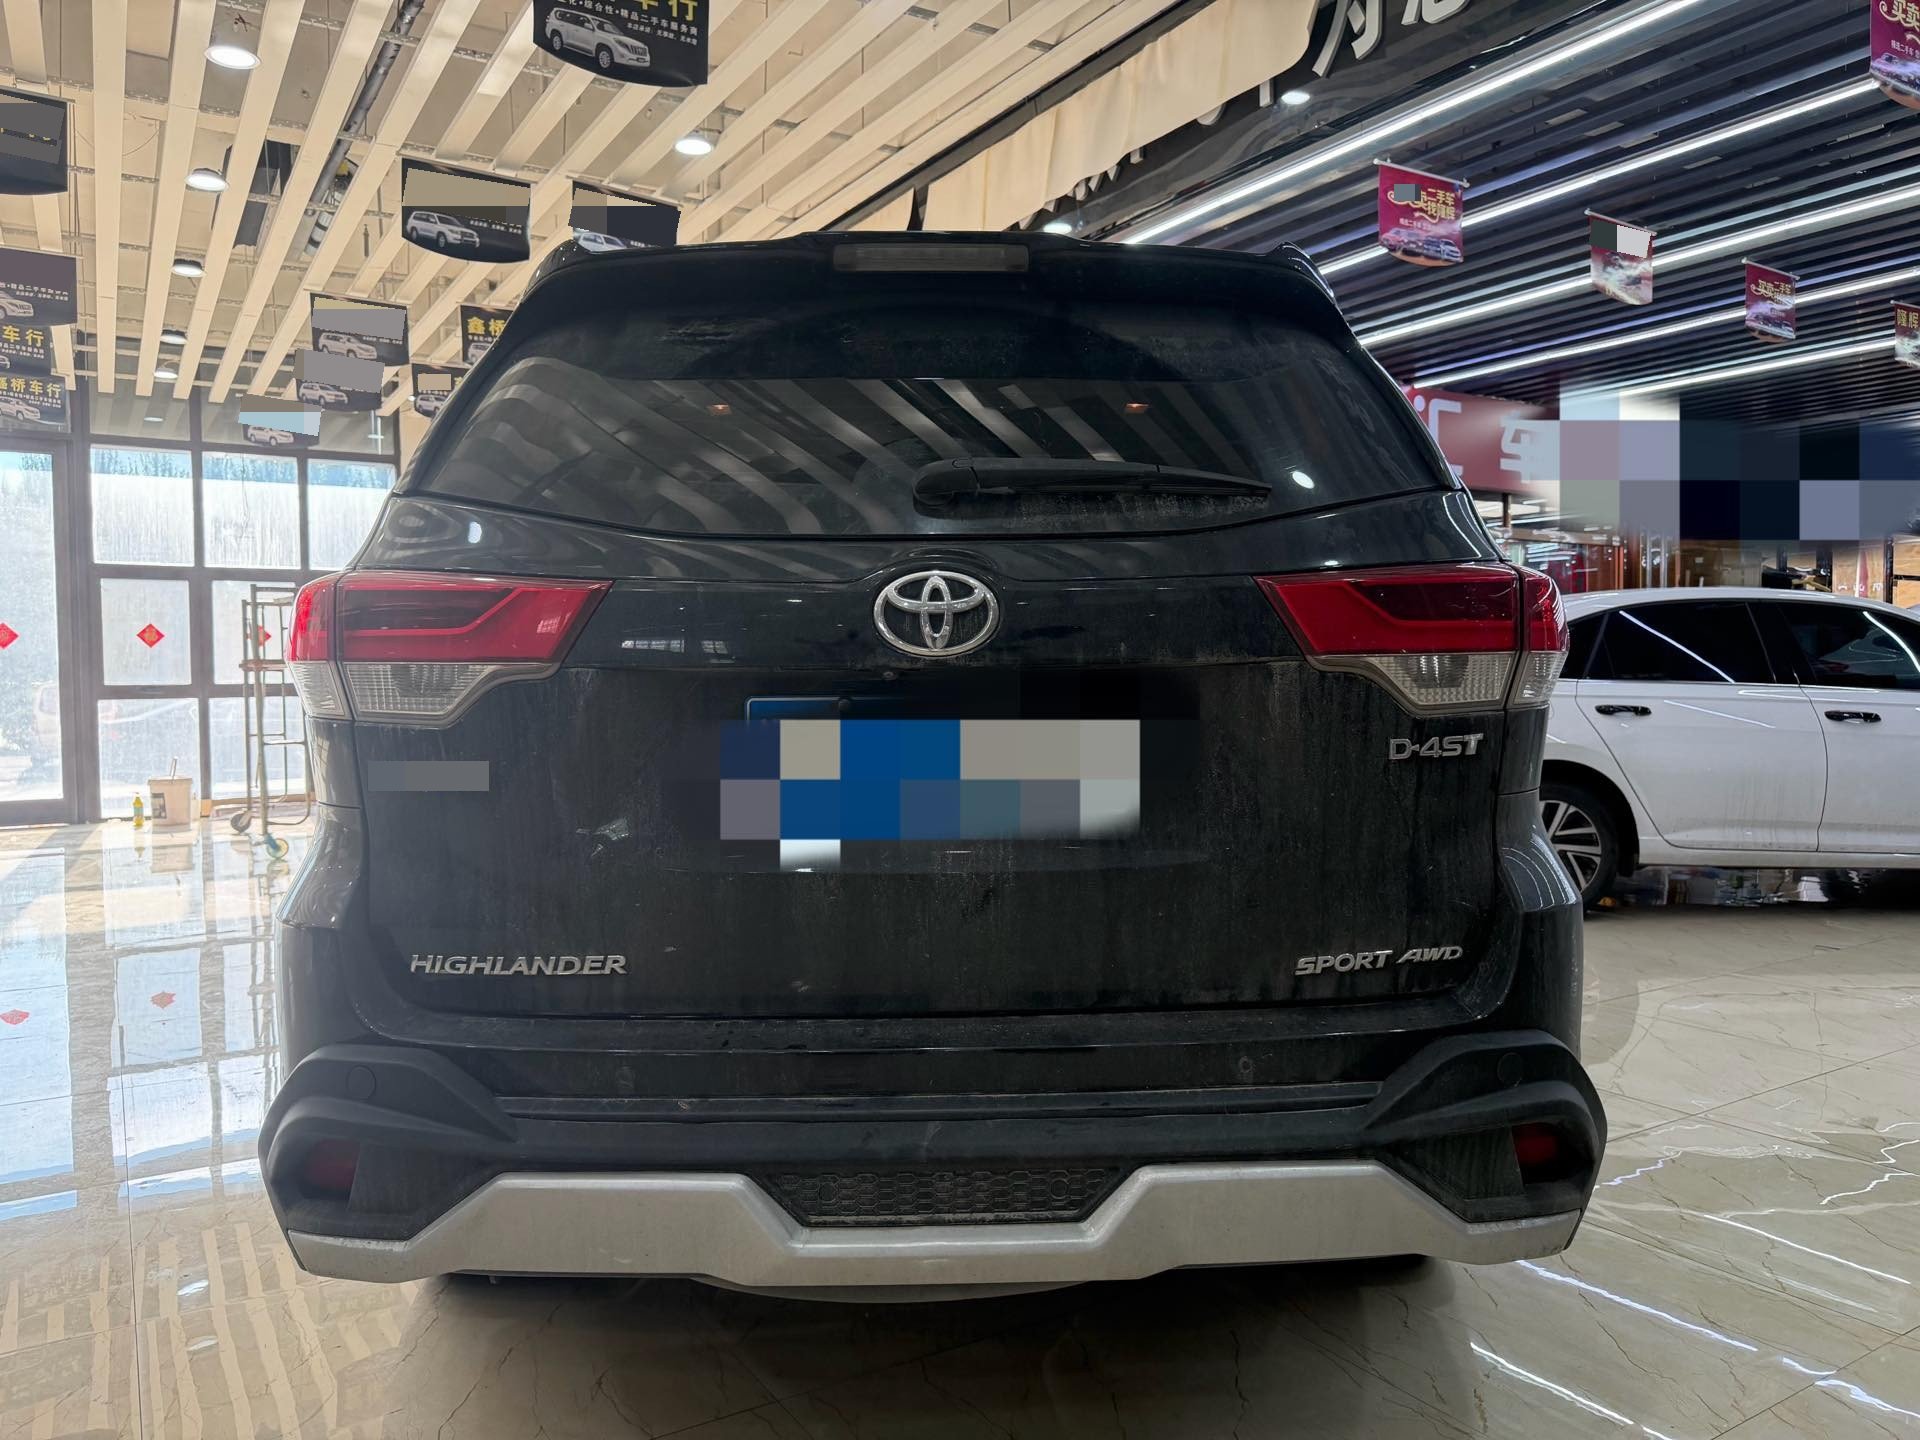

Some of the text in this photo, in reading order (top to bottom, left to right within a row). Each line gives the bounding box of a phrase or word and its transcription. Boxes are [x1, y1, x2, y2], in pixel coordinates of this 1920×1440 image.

[1389, 733, 1484, 760] D-4ST
[409, 954, 627, 976] HIGHLANDER
[1295, 946, 1463, 975] SPORT AWD
